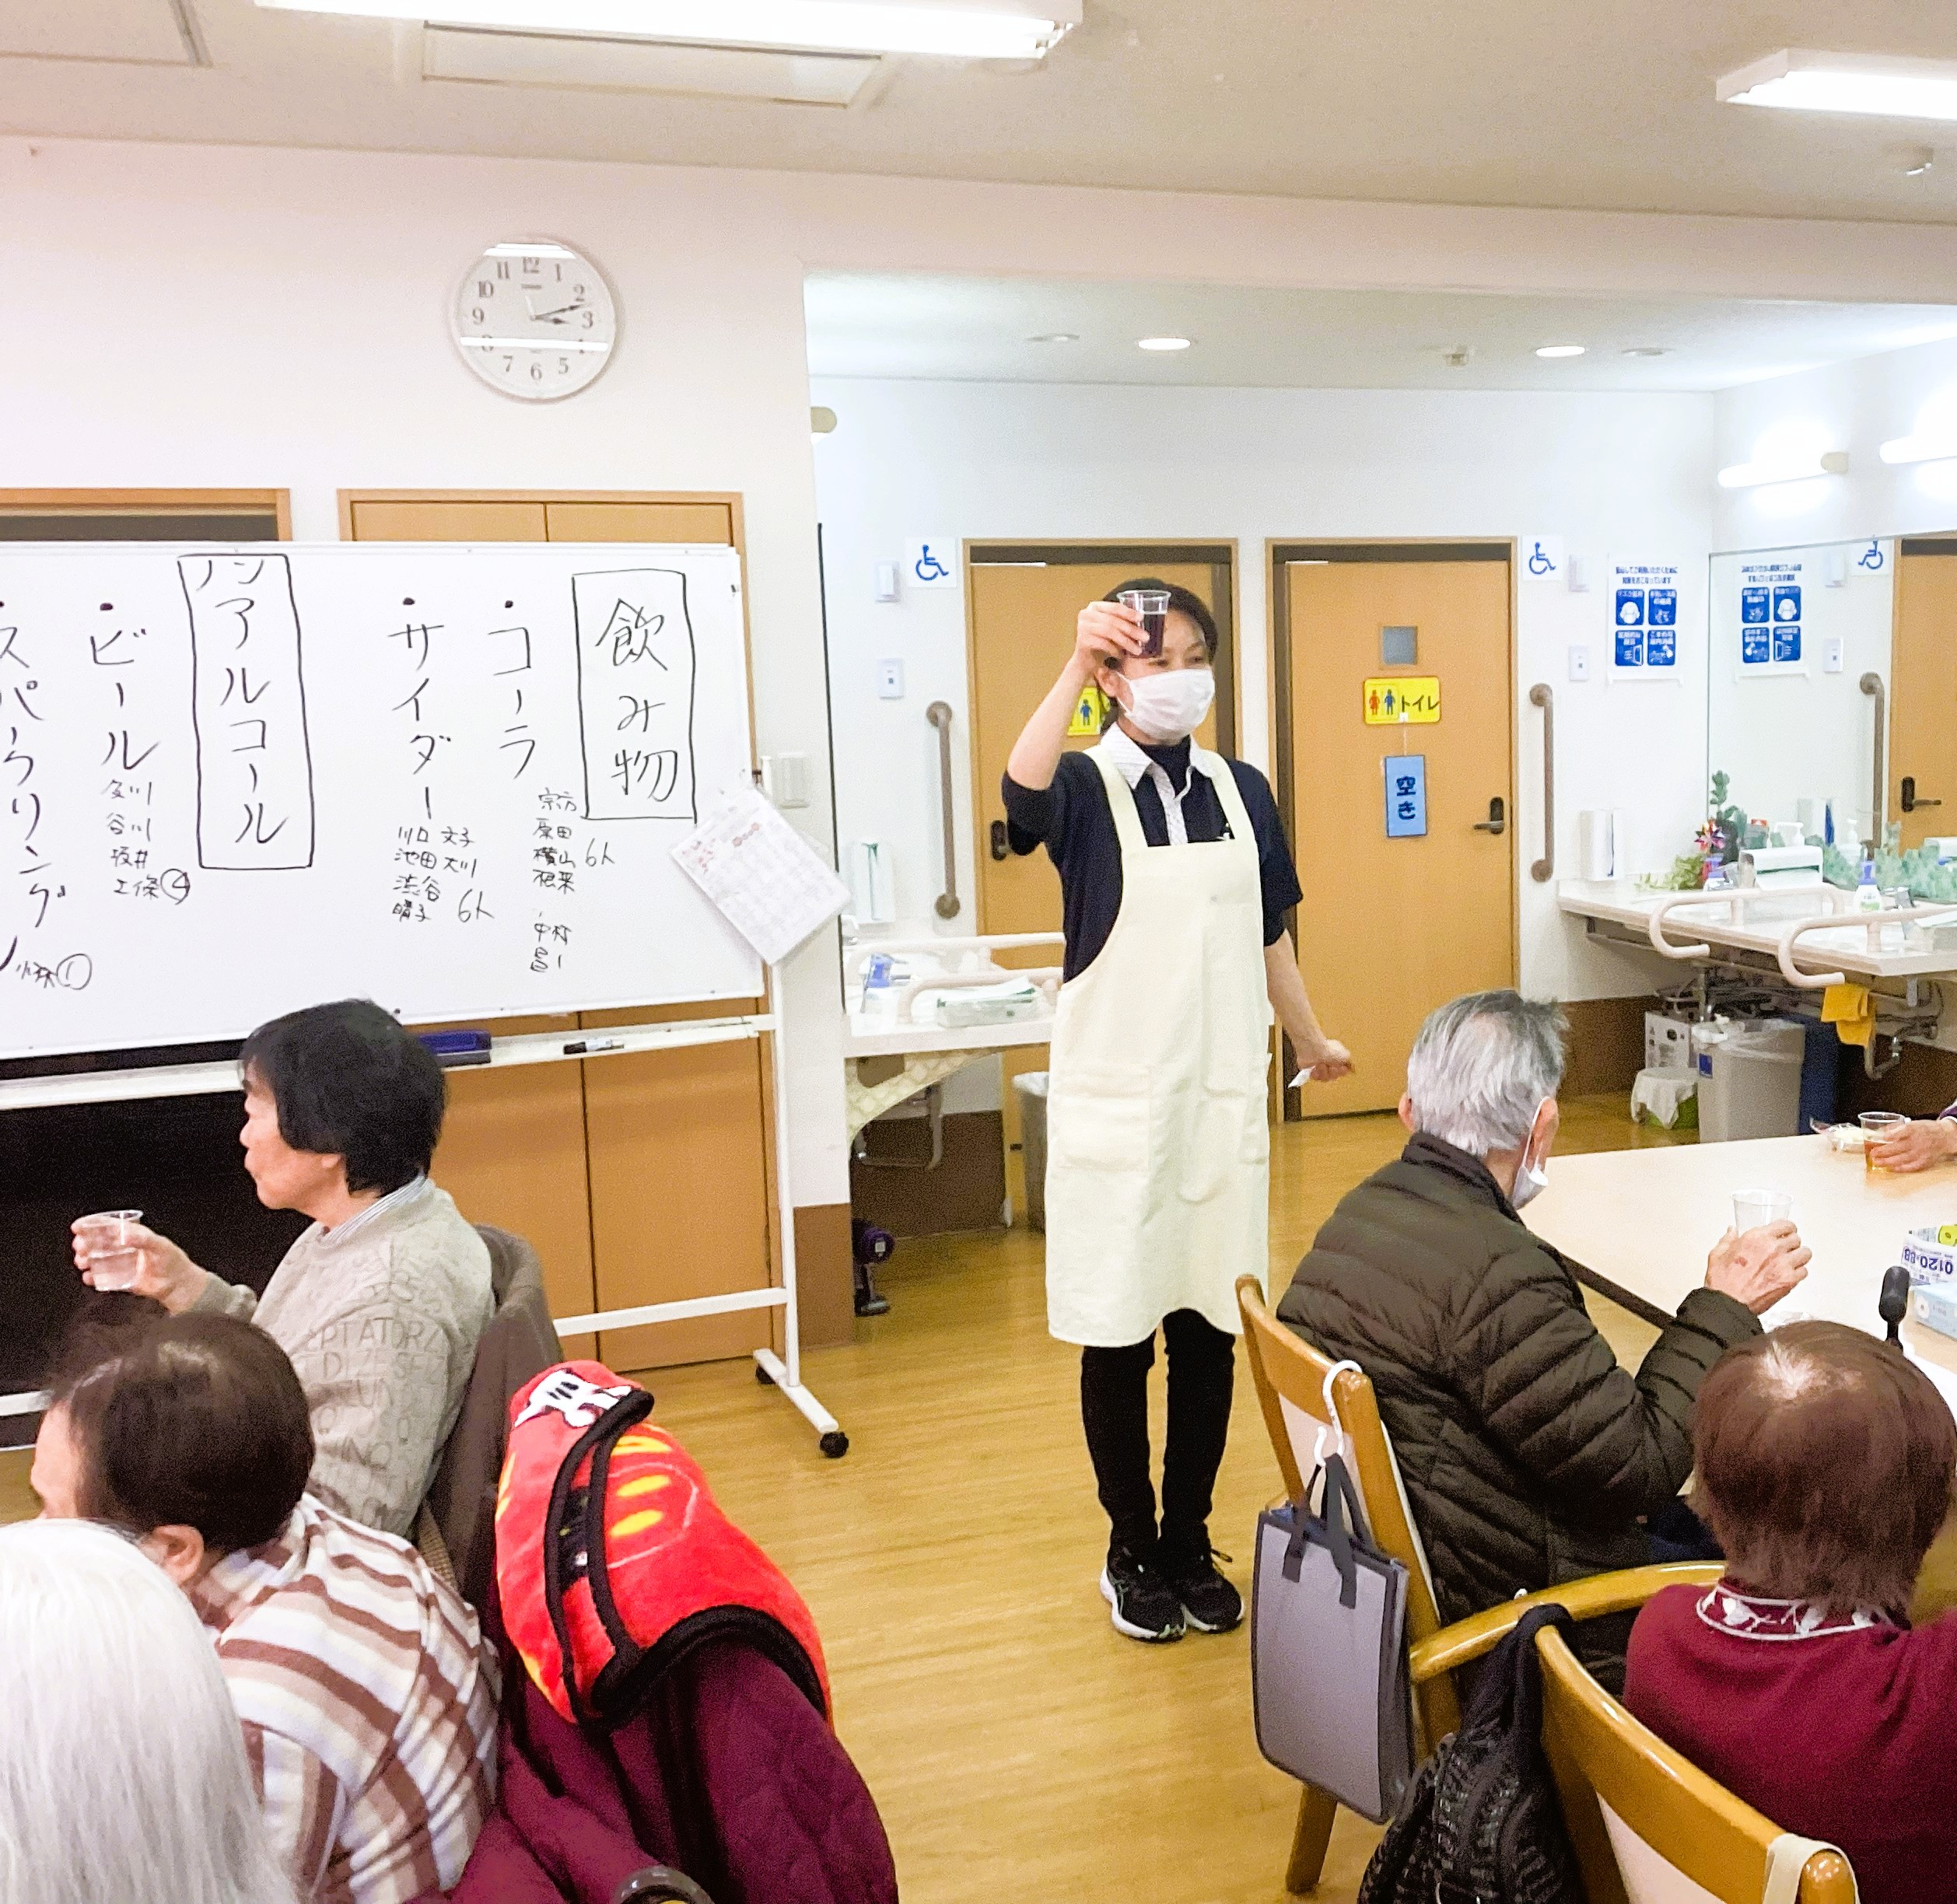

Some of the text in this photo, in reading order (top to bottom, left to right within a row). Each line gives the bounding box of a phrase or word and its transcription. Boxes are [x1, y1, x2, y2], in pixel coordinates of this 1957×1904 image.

[497, 261, 509, 279] 11
[523, 257, 540, 274] 12
[555, 264, 562, 282] 1
[478, 281, 494, 298] 10
[573, 284, 586, 302] 2
[472, 307, 485, 324] 9
[582, 311, 593, 328] 3
[503, 355, 513, 373] 7
[530, 362, 542, 380] 6
[558, 357, 569, 375] 5
[596, 598, 678, 802] 飲み物
[1402, 695, 1439, 712] トイレ
[1396, 775, 1416, 820] 空き
